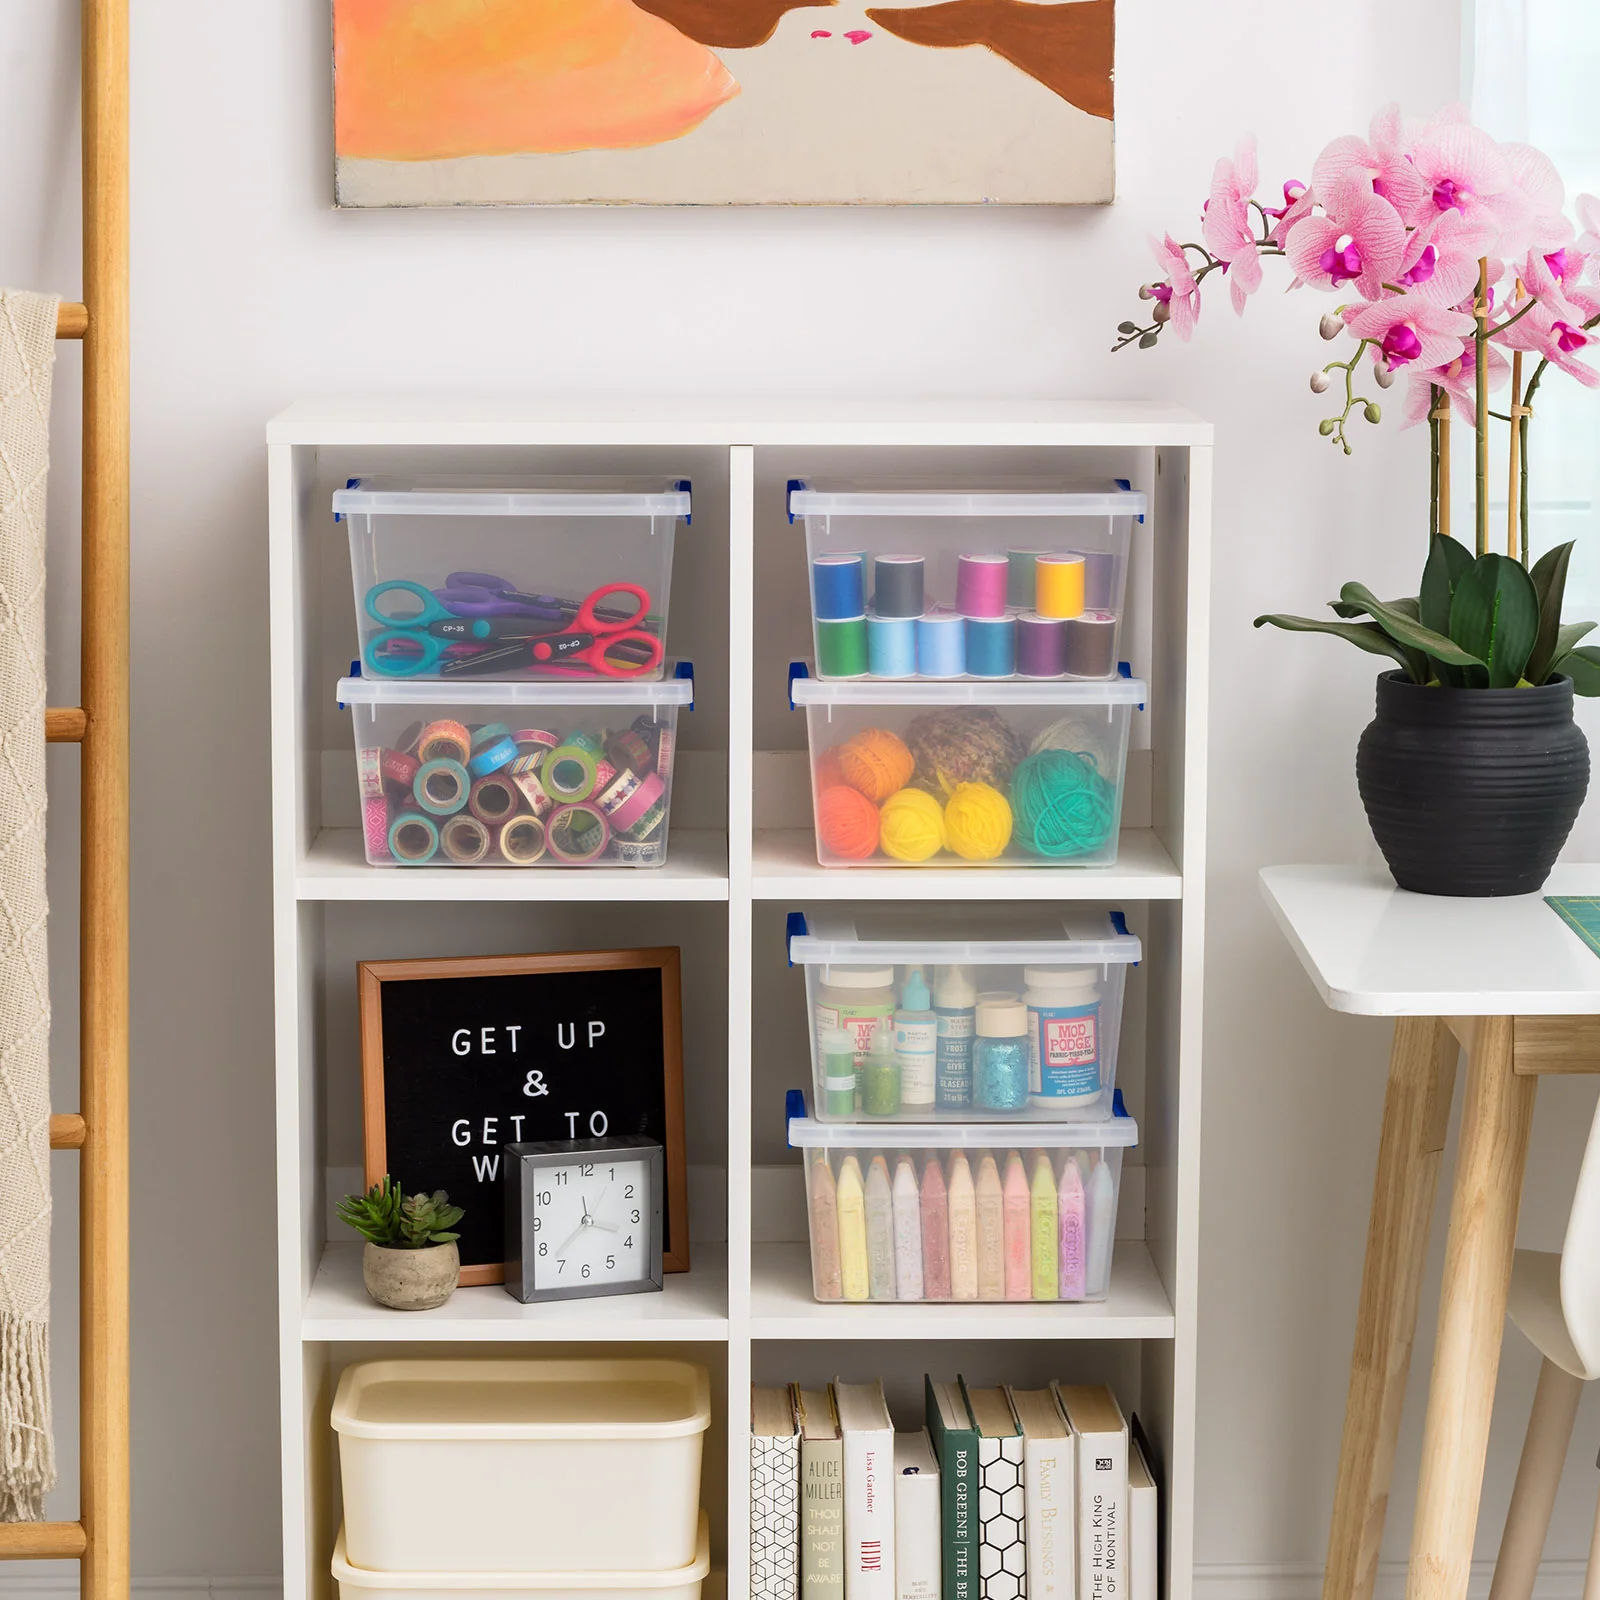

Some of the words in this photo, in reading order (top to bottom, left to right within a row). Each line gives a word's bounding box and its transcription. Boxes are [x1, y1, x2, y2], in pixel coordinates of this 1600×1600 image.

[558, 640, 580, 650] CP-02
[1058, 1023, 1086, 1038] MOD
[452, 1025, 522, 1056] GET
[557, 1021, 606, 1049] UP
[1050, 1036, 1092, 1051] PODGE
[522, 1069, 549, 1097] &
[452, 1115, 526, 1147] GET
[564, 1110, 608, 1139] TO
[578, 1163, 594, 1176] 12
[608, 1168, 614, 1181] 1
[554, 1171, 568, 1185] 11
[536, 1191, 551, 1206] 10
[624, 1185, 634, 1199] 2
[630, 1209, 640, 1224] 3
[534, 1218, 542, 1232] 9
[538, 1242, 548, 1256] 8
[624, 1235, 633, 1249] 4
[1064, 1215, 1080, 1274] Crayola
[557, 1260, 566, 1274] 7
[606, 1255, 615, 1269] 5
[582, 1264, 590, 1278] 6
[809, 1461, 838, 1478] ALICE
[866, 1452, 875, 1472] Lisa
[956, 1450, 967, 1478] BOB
[806, 1483, 842, 1500] MILLER
[866, 1474, 876, 1513] Gardner
[808, 1508, 840, 1520] THOU
[956, 1482, 968, 1538] GREENE
[1093, 1494, 1102, 1528] KING
[808, 1524, 841, 1536] SHALT
[1106, 1502, 1116, 1570] MONTIVAL
[812, 1542, 836, 1552] NOT
[1093, 1534, 1102, 1568] HIGH
[818, 1558, 830, 1568] BE
[861, 1541, 881, 1572] HIDE
[956, 1548, 968, 1577] THE
[806, 1574, 842, 1584] AWARE
[1107, 1576, 1116, 1593] OF
[956, 1582, 968, 1599] BE
[1093, 1574, 1102, 1600] THE
